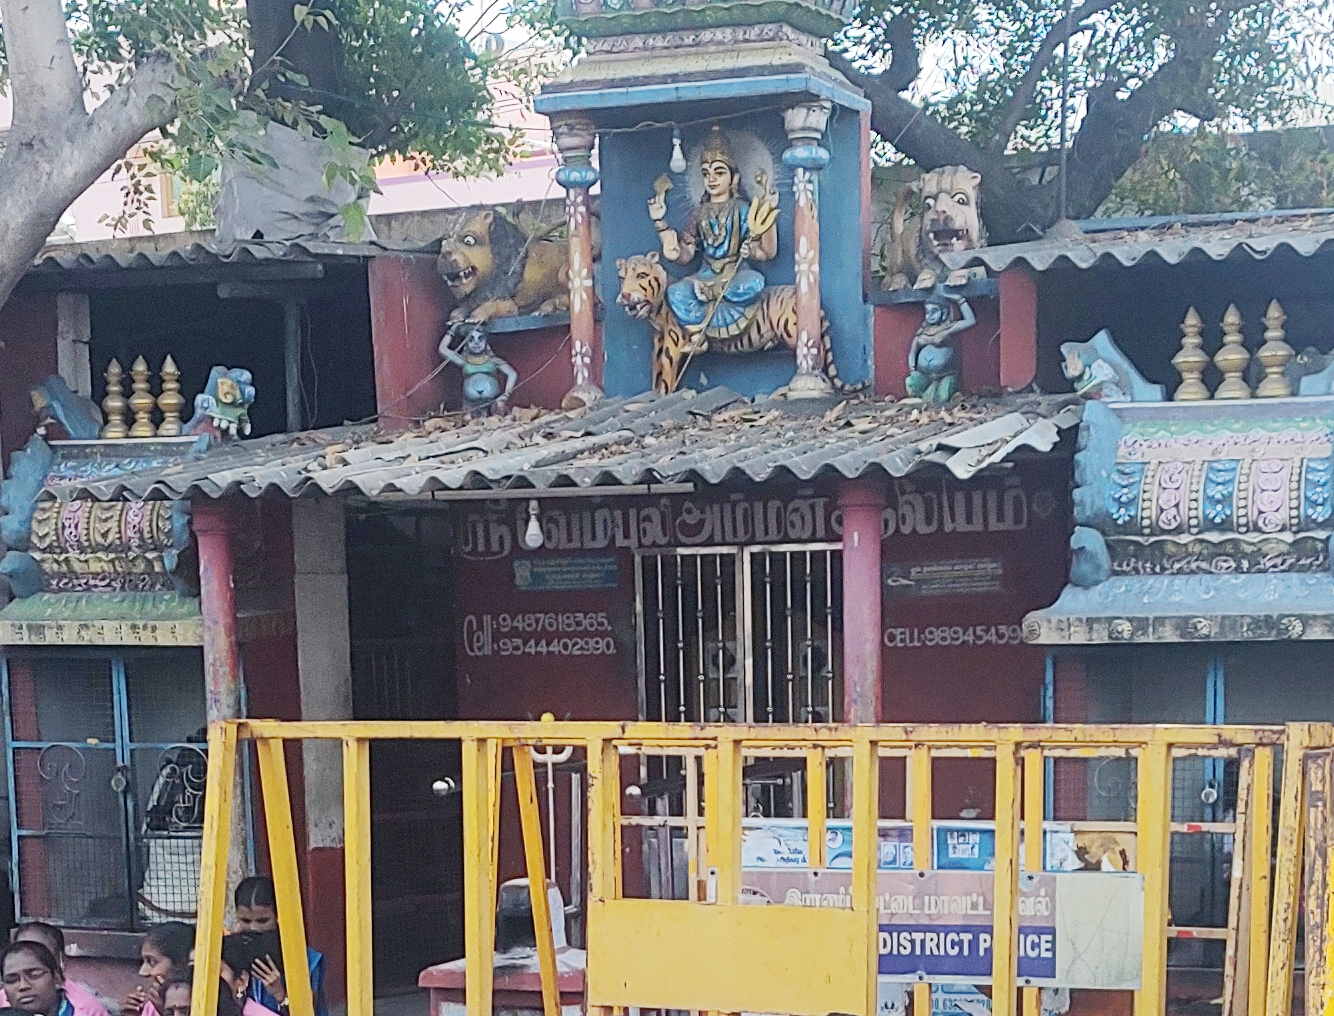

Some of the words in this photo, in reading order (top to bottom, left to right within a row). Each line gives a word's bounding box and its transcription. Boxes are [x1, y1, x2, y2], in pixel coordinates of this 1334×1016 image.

[676, 491, 829, 544] அம்மன்
[879, 931, 974, 957] DISTRICT
[979, 934, 1053, 958] PICE
